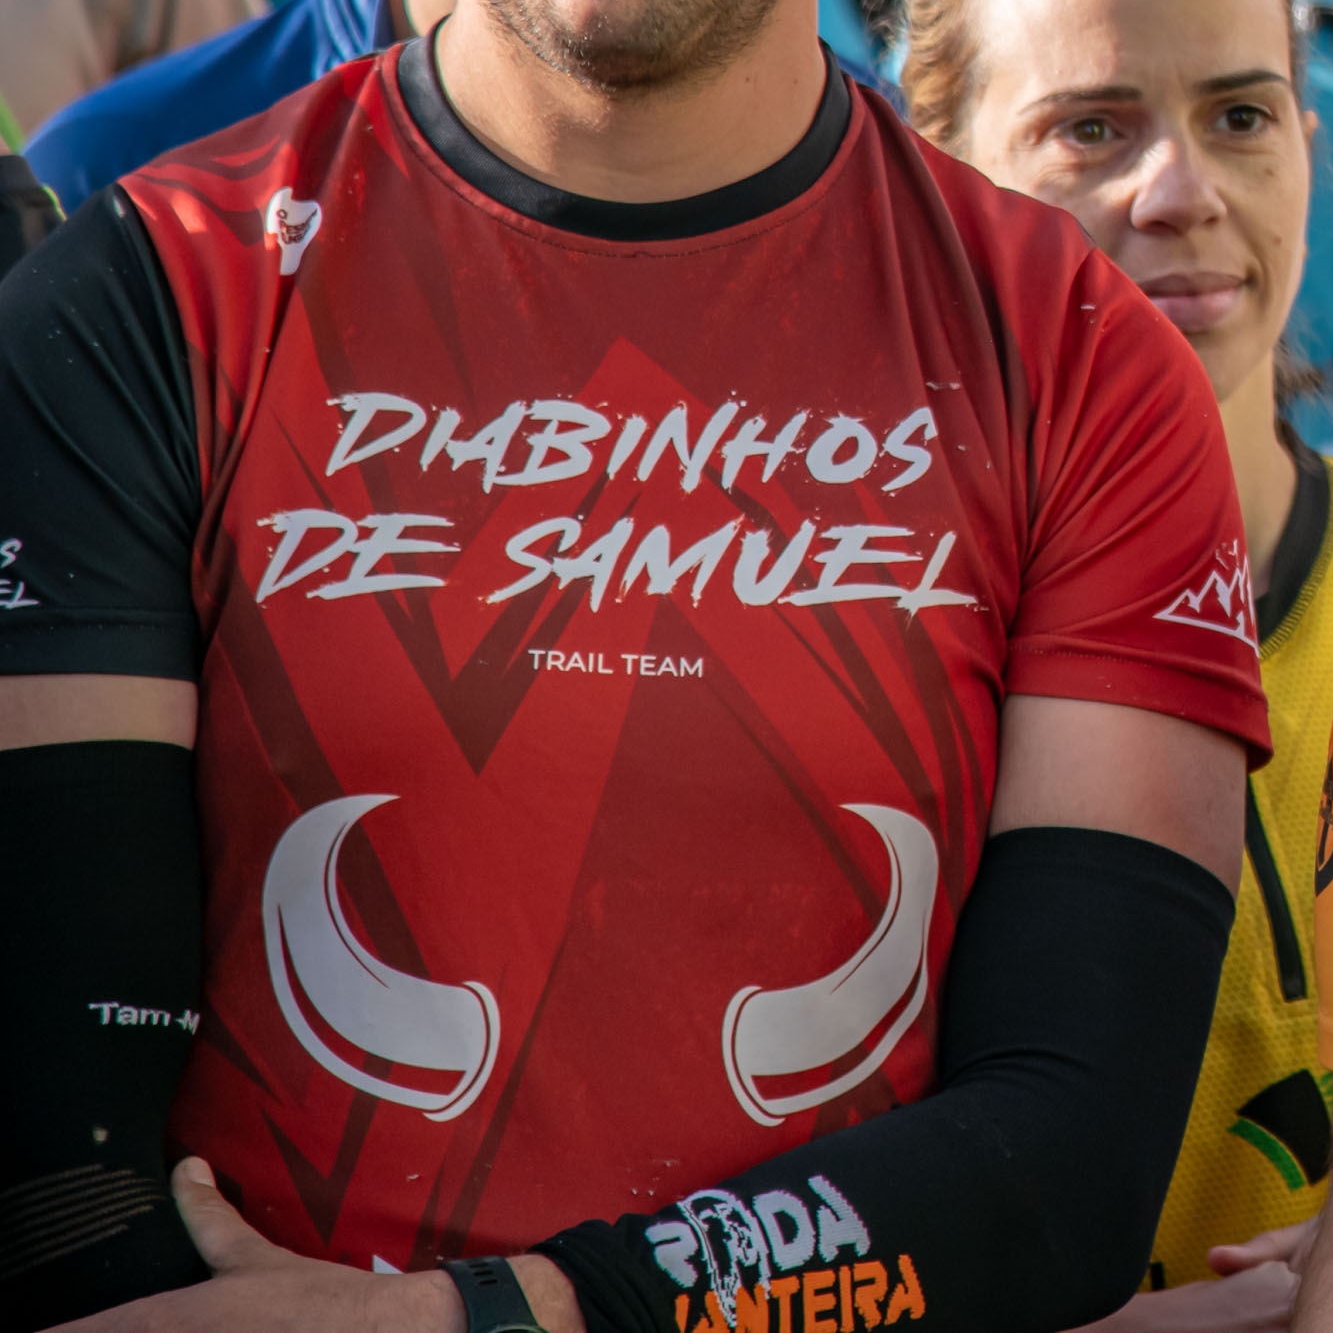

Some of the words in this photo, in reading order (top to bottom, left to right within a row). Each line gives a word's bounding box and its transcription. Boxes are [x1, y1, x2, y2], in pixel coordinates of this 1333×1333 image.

[326, 391, 938, 494] DIABINHOS
[256, 508, 461, 604] DE
[485, 514, 978, 613] SAMUEL
[528, 649, 614, 675] TRAIL
[620, 653, 703, 679] TEAM
